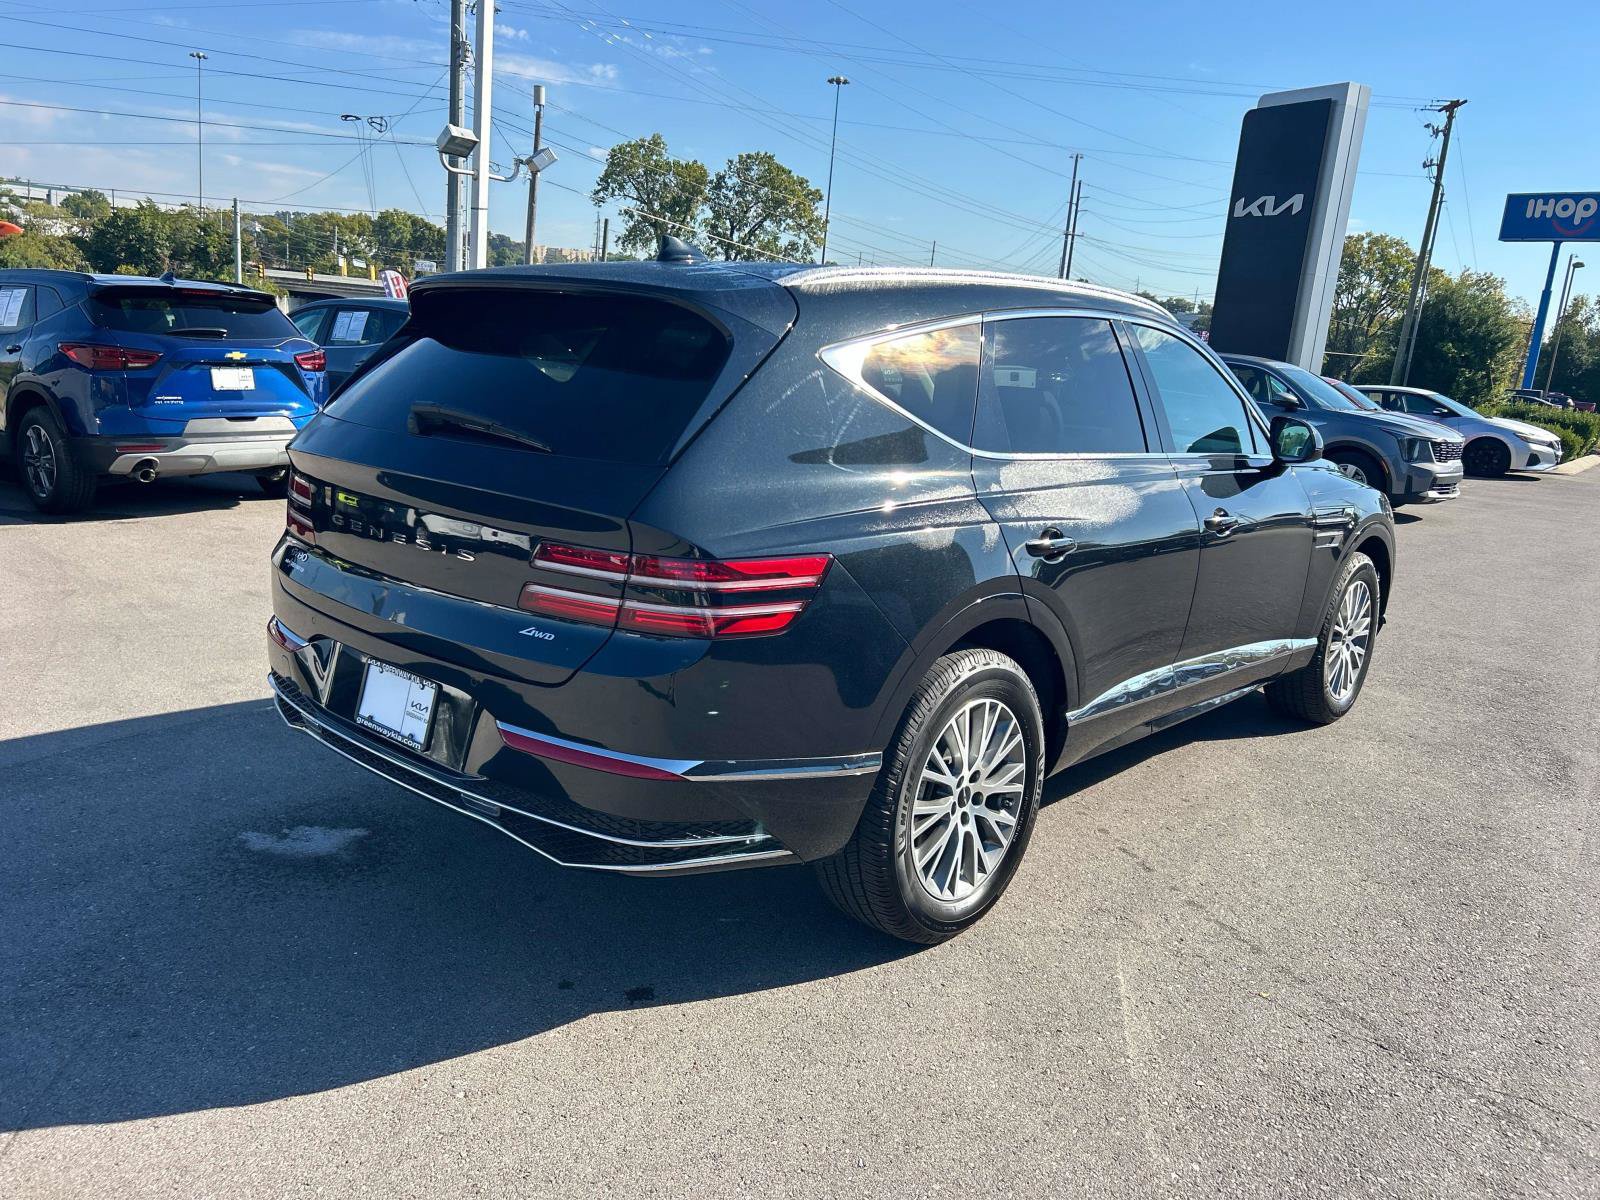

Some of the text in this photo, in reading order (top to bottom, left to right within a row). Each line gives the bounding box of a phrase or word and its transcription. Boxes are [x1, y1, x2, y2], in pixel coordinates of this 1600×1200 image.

[1234, 194, 1304, 217] KIA
[331, 514, 476, 562] GENESIS
[411, 700, 429, 713] KIA
[356, 717, 421, 749] greenwaykia.com
